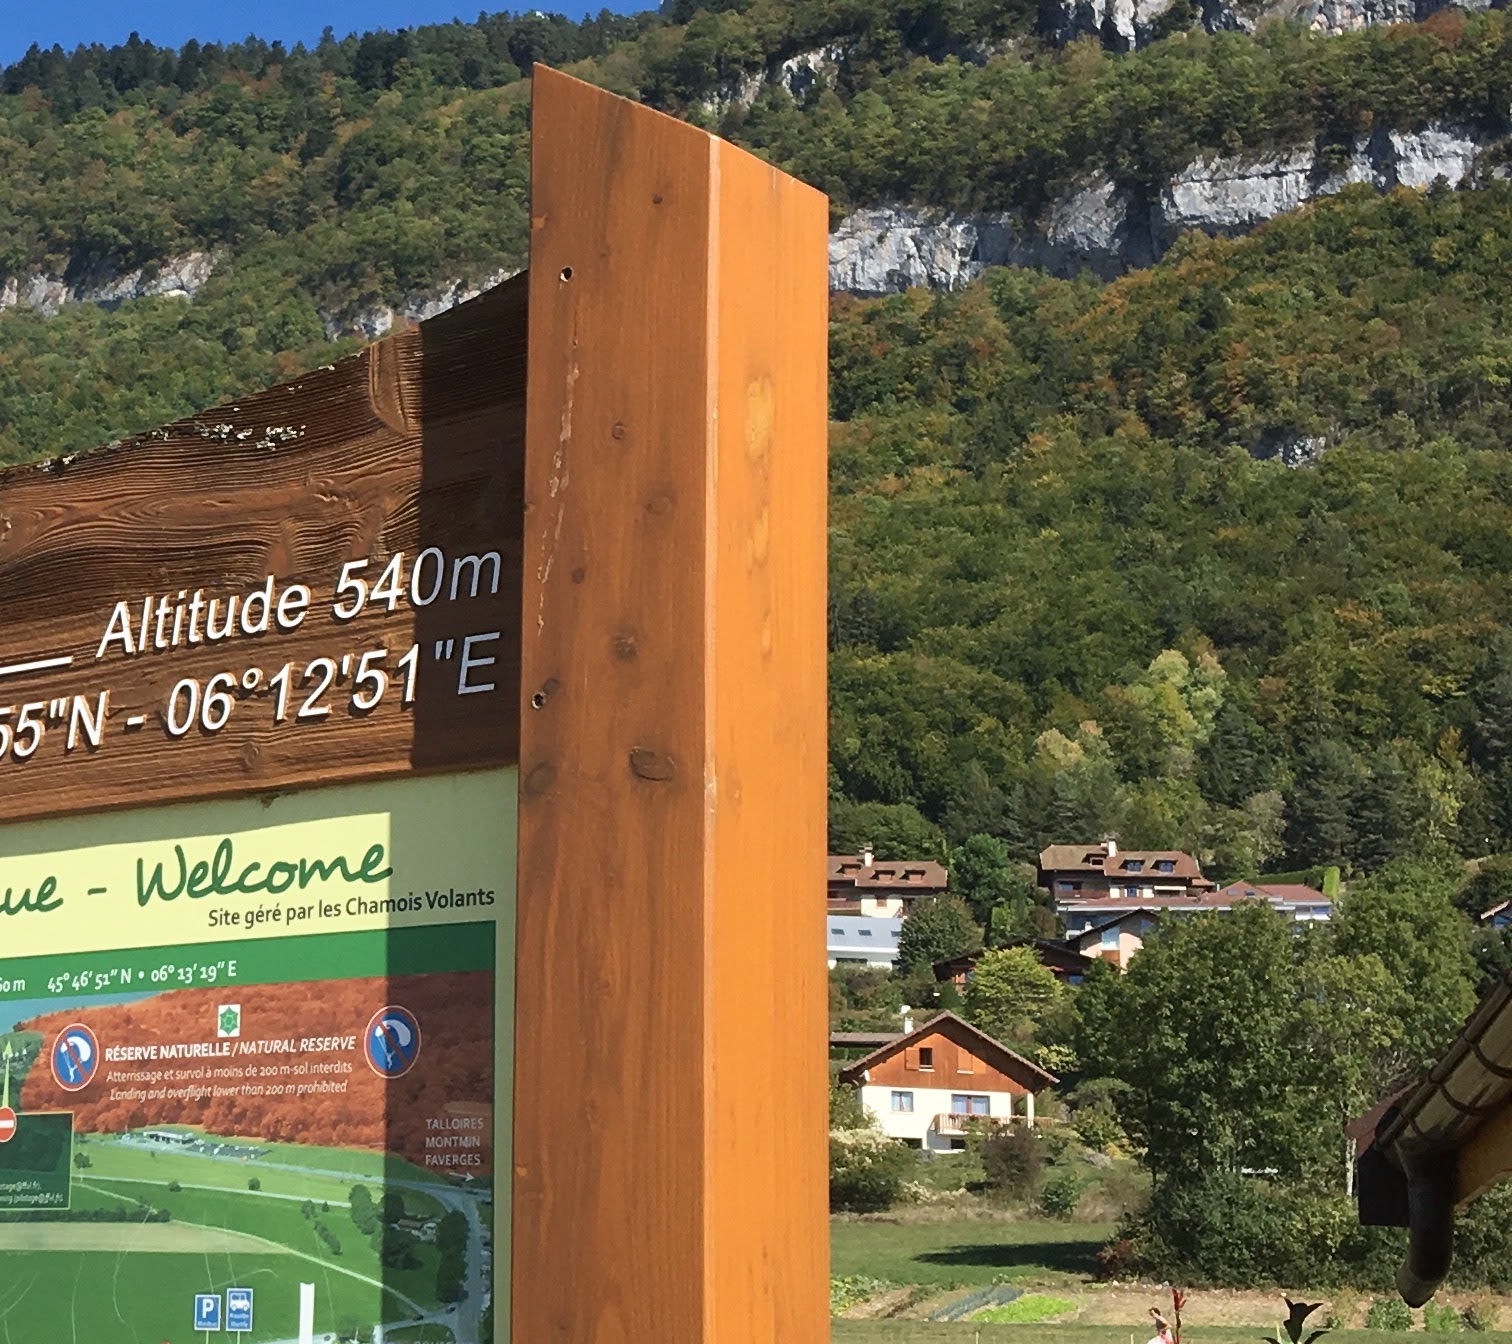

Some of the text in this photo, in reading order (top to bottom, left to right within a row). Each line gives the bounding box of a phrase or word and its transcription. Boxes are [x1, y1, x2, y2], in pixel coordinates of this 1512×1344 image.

[96, 548, 501, 659] Altitude 540m
[167, 632, 500, 738] 06°12'51"E
[137, 841, 392, 906] Welcome
[208, 888, 495, 930] Site géré par les Chamois Volants
[13, 979, 25, 991] m
[105, 1045, 158, 1061] RÉSERVE
[160, 1042, 230, 1058] NATURELLE
[239, 1038, 296, 1054] NATURAL
[299, 1036, 356, 1051] RESERVE
[107, 1061, 353, 1082] Atterrissage et survol à moins de 200 m-sol interdits
[110, 1080, 348, 1102] Landing and overflight lower than 200 m prohibited
[426, 1117, 484, 1131] TALLOIRES
[426, 1135, 481, 1149] MONTMIN
[425, 1153, 481, 1167] FAVERGES
[202, 1299, 214, 1318] P
